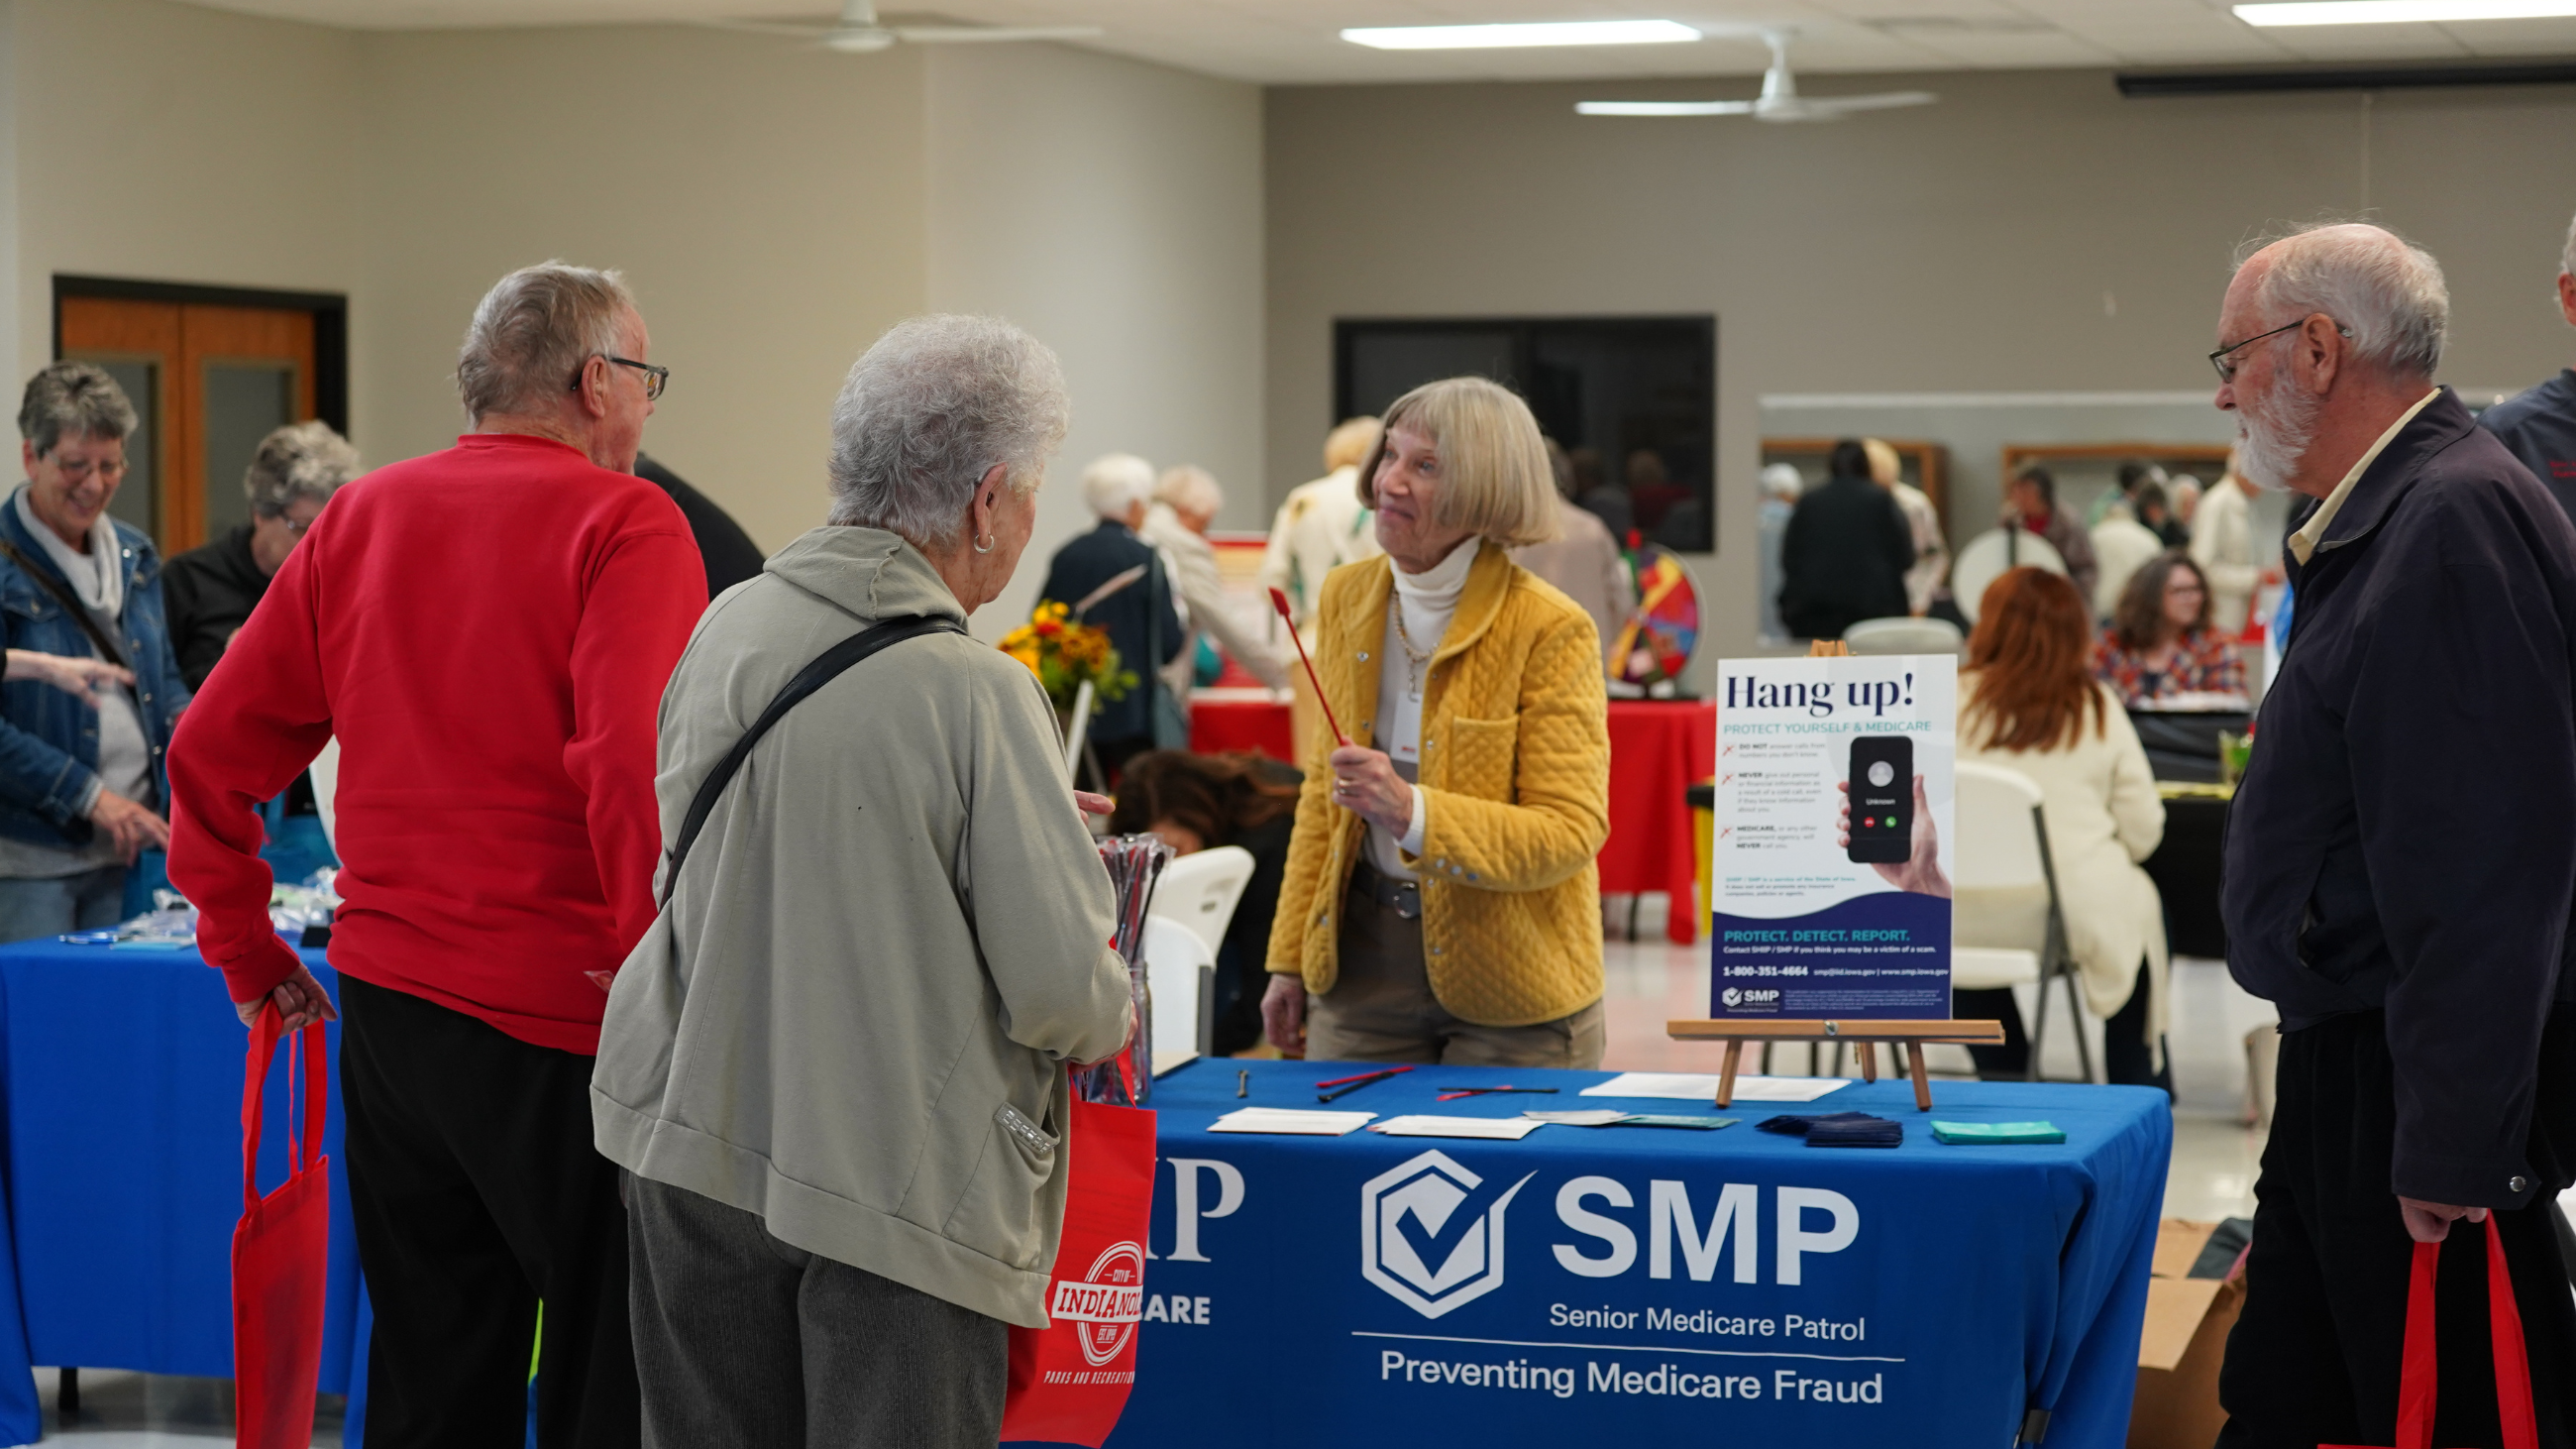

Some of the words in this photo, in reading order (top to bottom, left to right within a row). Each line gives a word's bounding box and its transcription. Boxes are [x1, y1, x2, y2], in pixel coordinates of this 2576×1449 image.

[1726, 676, 1835, 718] Hang
[1848, 673, 1913, 717] up!
[1724, 724, 1780, 734] PROTECT
[1784, 723, 1850, 733] YOURSELF
[1854, 722, 1862, 732] &
[1866, 721, 1932, 732] MEDICARE
[1724, 931, 1789, 942] PROTECT.
[1792, 930, 1848, 942] DETECT.
[1852, 930, 1910, 942] REPORT.
[1744, 989, 1779, 1002] SMP
[1552, 1175, 1860, 1286] SMP
[1058, 1286, 1141, 1318] INDIANOL
[1140, 1294, 1211, 1325] ARE
[1550, 1303, 1639, 1331] Senior
[1647, 1306, 1775, 1337] Medicare
[1784, 1314, 1866, 1341] Patrol
[1043, 1371, 1073, 1384] PARKS
[1072, 1372, 1090, 1385] AND
[1381, 1350, 1575, 1398] Preventing
[1587, 1361, 1762, 1400] Medicare
[1774, 1370, 1883, 1404] Fraud
